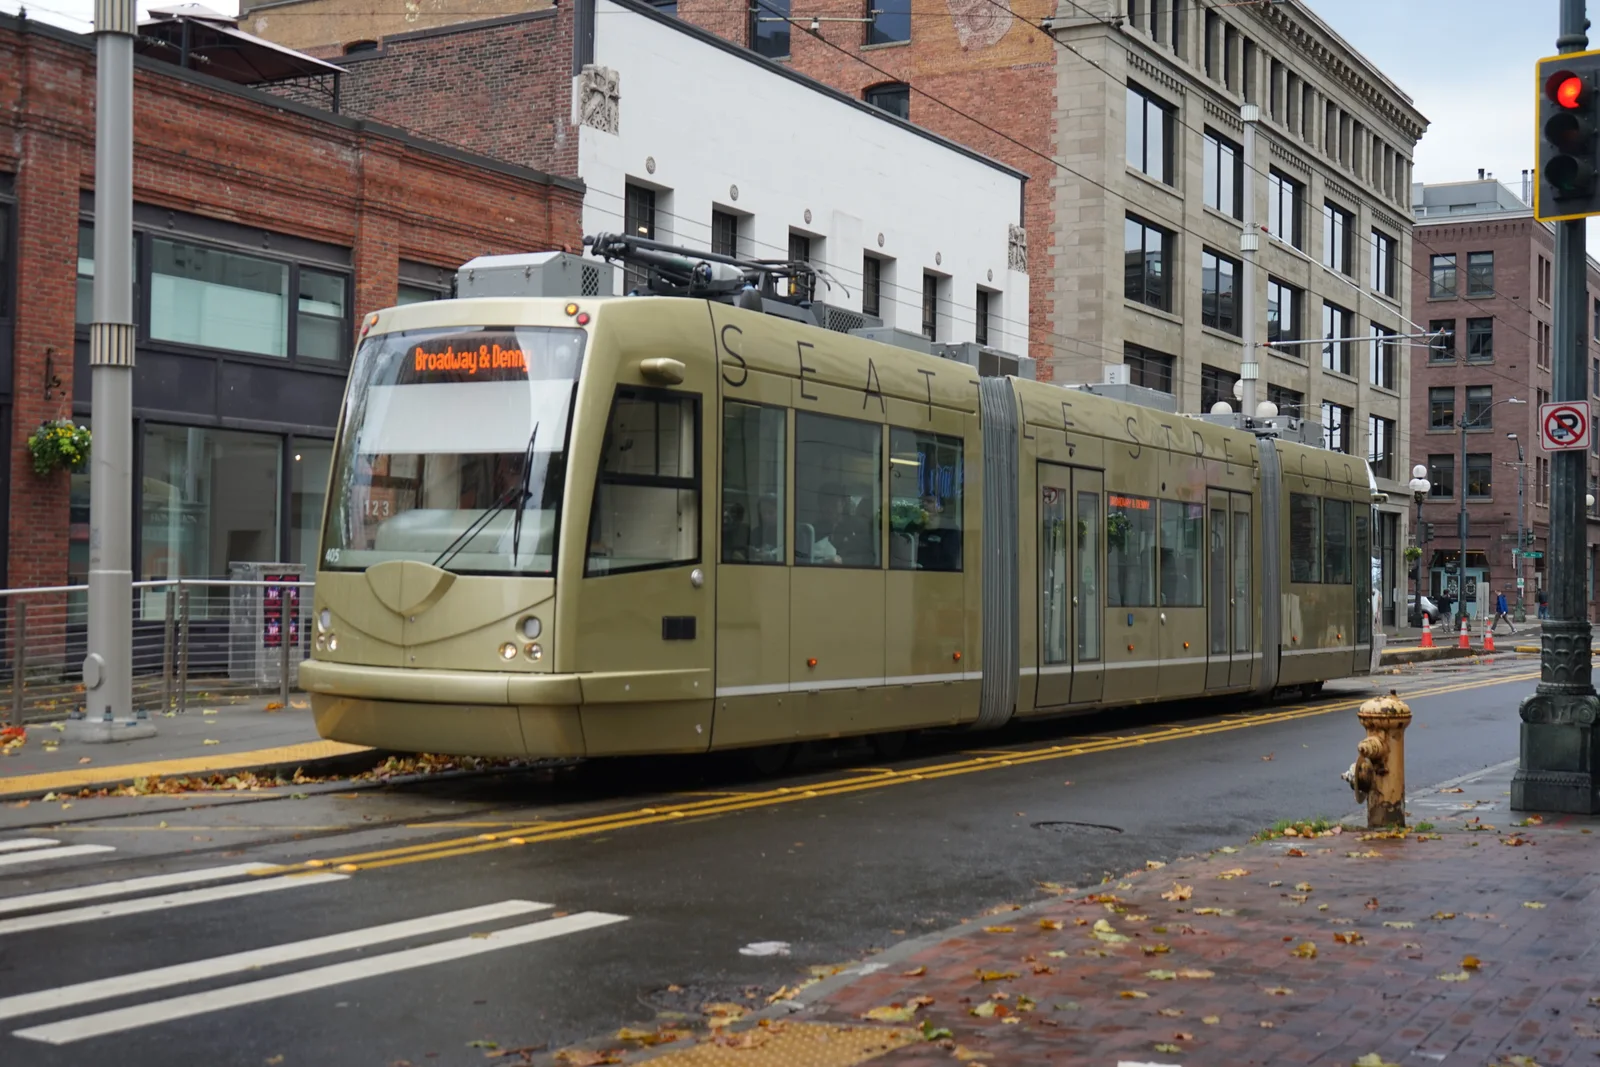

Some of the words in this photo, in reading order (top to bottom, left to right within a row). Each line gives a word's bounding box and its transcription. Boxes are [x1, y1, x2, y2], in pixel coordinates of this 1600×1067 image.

[415, 346, 477, 374] Broadway
[479, 344, 491, 368] &
[492, 344, 532, 373] Denny
[721, 324, 1077, 448] SEATTLE
[1126, 417, 1355, 496] STREETCAR
[325, 547, 341, 562] 405
